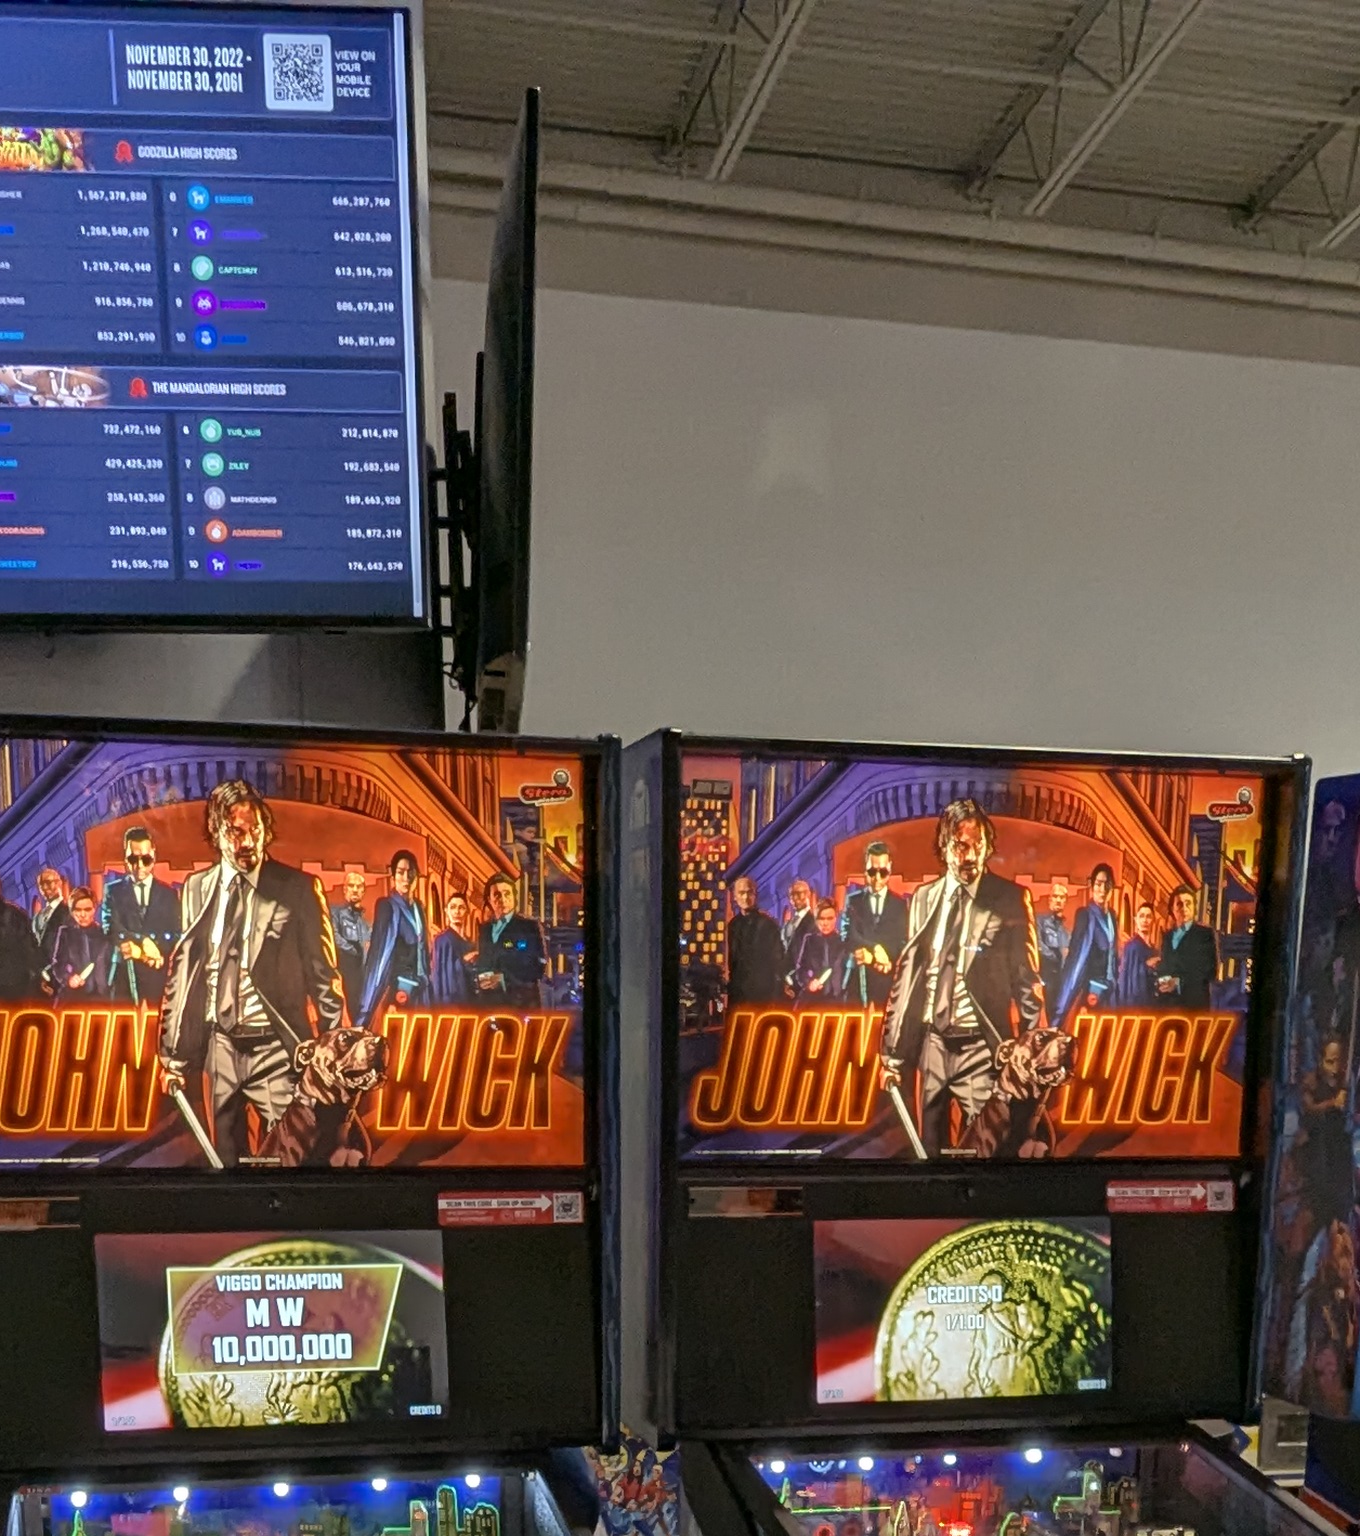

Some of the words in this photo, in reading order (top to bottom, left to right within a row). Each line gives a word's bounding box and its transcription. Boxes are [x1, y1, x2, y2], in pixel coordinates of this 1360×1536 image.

[126, 43, 191, 66] NOVEMBER
[193, 46, 213, 68] 30,
[214, 46, 244, 68] 2022
[335, 50, 359, 61] VIEW
[361, 50, 376, 61] ON
[335, 62, 361, 73] YOUR
[127, 69, 193, 91] NOVEMBER
[194, 70, 214, 93] 30,
[215, 71, 244, 93] 2061
[336, 74, 372, 86] MOBILE
[337, 87, 371, 98] DEVICE
[138, 143, 179, 159] GODZILLA
[180, 147, 202, 160] HIGH
[204, 147, 238, 160] SCORES
[176, 333, 186, 341] 10
[152, 382, 168, 393] THE
[170, 382, 229, 395] MANDALORIAN
[231, 384, 252, 395] HIGH
[253, 384, 286, 396] SCORES
[189, 559, 199, 568] 10
[374, 1014, 570, 1132] WICK
[693, 1010, 883, 1127] JOHN
[1060, 1014, 1236, 1126] WICK
[216, 1274, 262, 1292] VIGGO
[265, 1272, 343, 1291] CHAMPION
[927, 1285, 989, 1304] CREDITS
[991, 1285, 1003, 1302] 0
[246, 1298, 270, 1328] M
[276, 1297, 304, 1327] W
[945, 1313, 985, 1331] 1/1.00
[212, 1333, 353, 1366] 10,000,000
[409, 1405, 437, 1417] CREDITS
